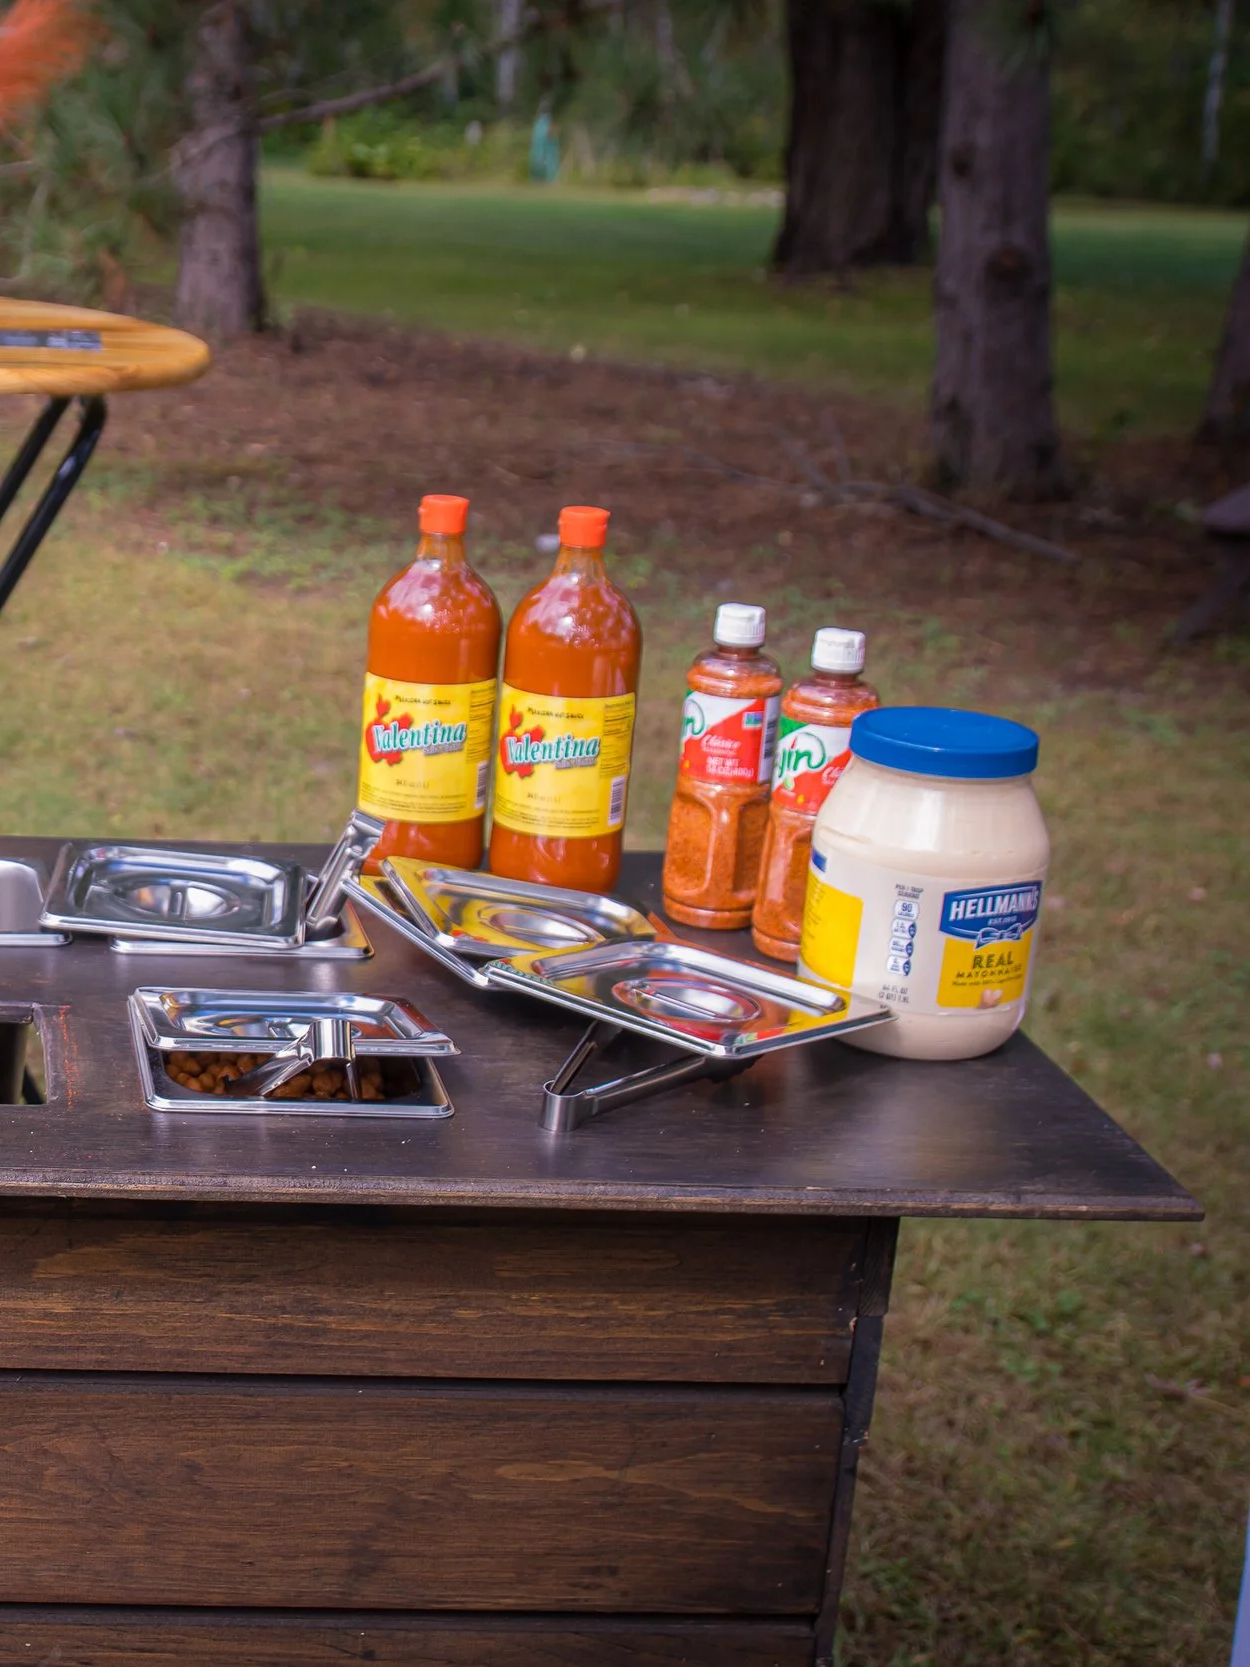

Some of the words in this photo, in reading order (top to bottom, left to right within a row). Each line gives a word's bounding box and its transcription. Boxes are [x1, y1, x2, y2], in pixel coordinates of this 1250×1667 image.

[373, 720, 467, 752] Valentina
[506, 733, 600, 764] Valentina
[972, 951, 1015, 970] REAL
